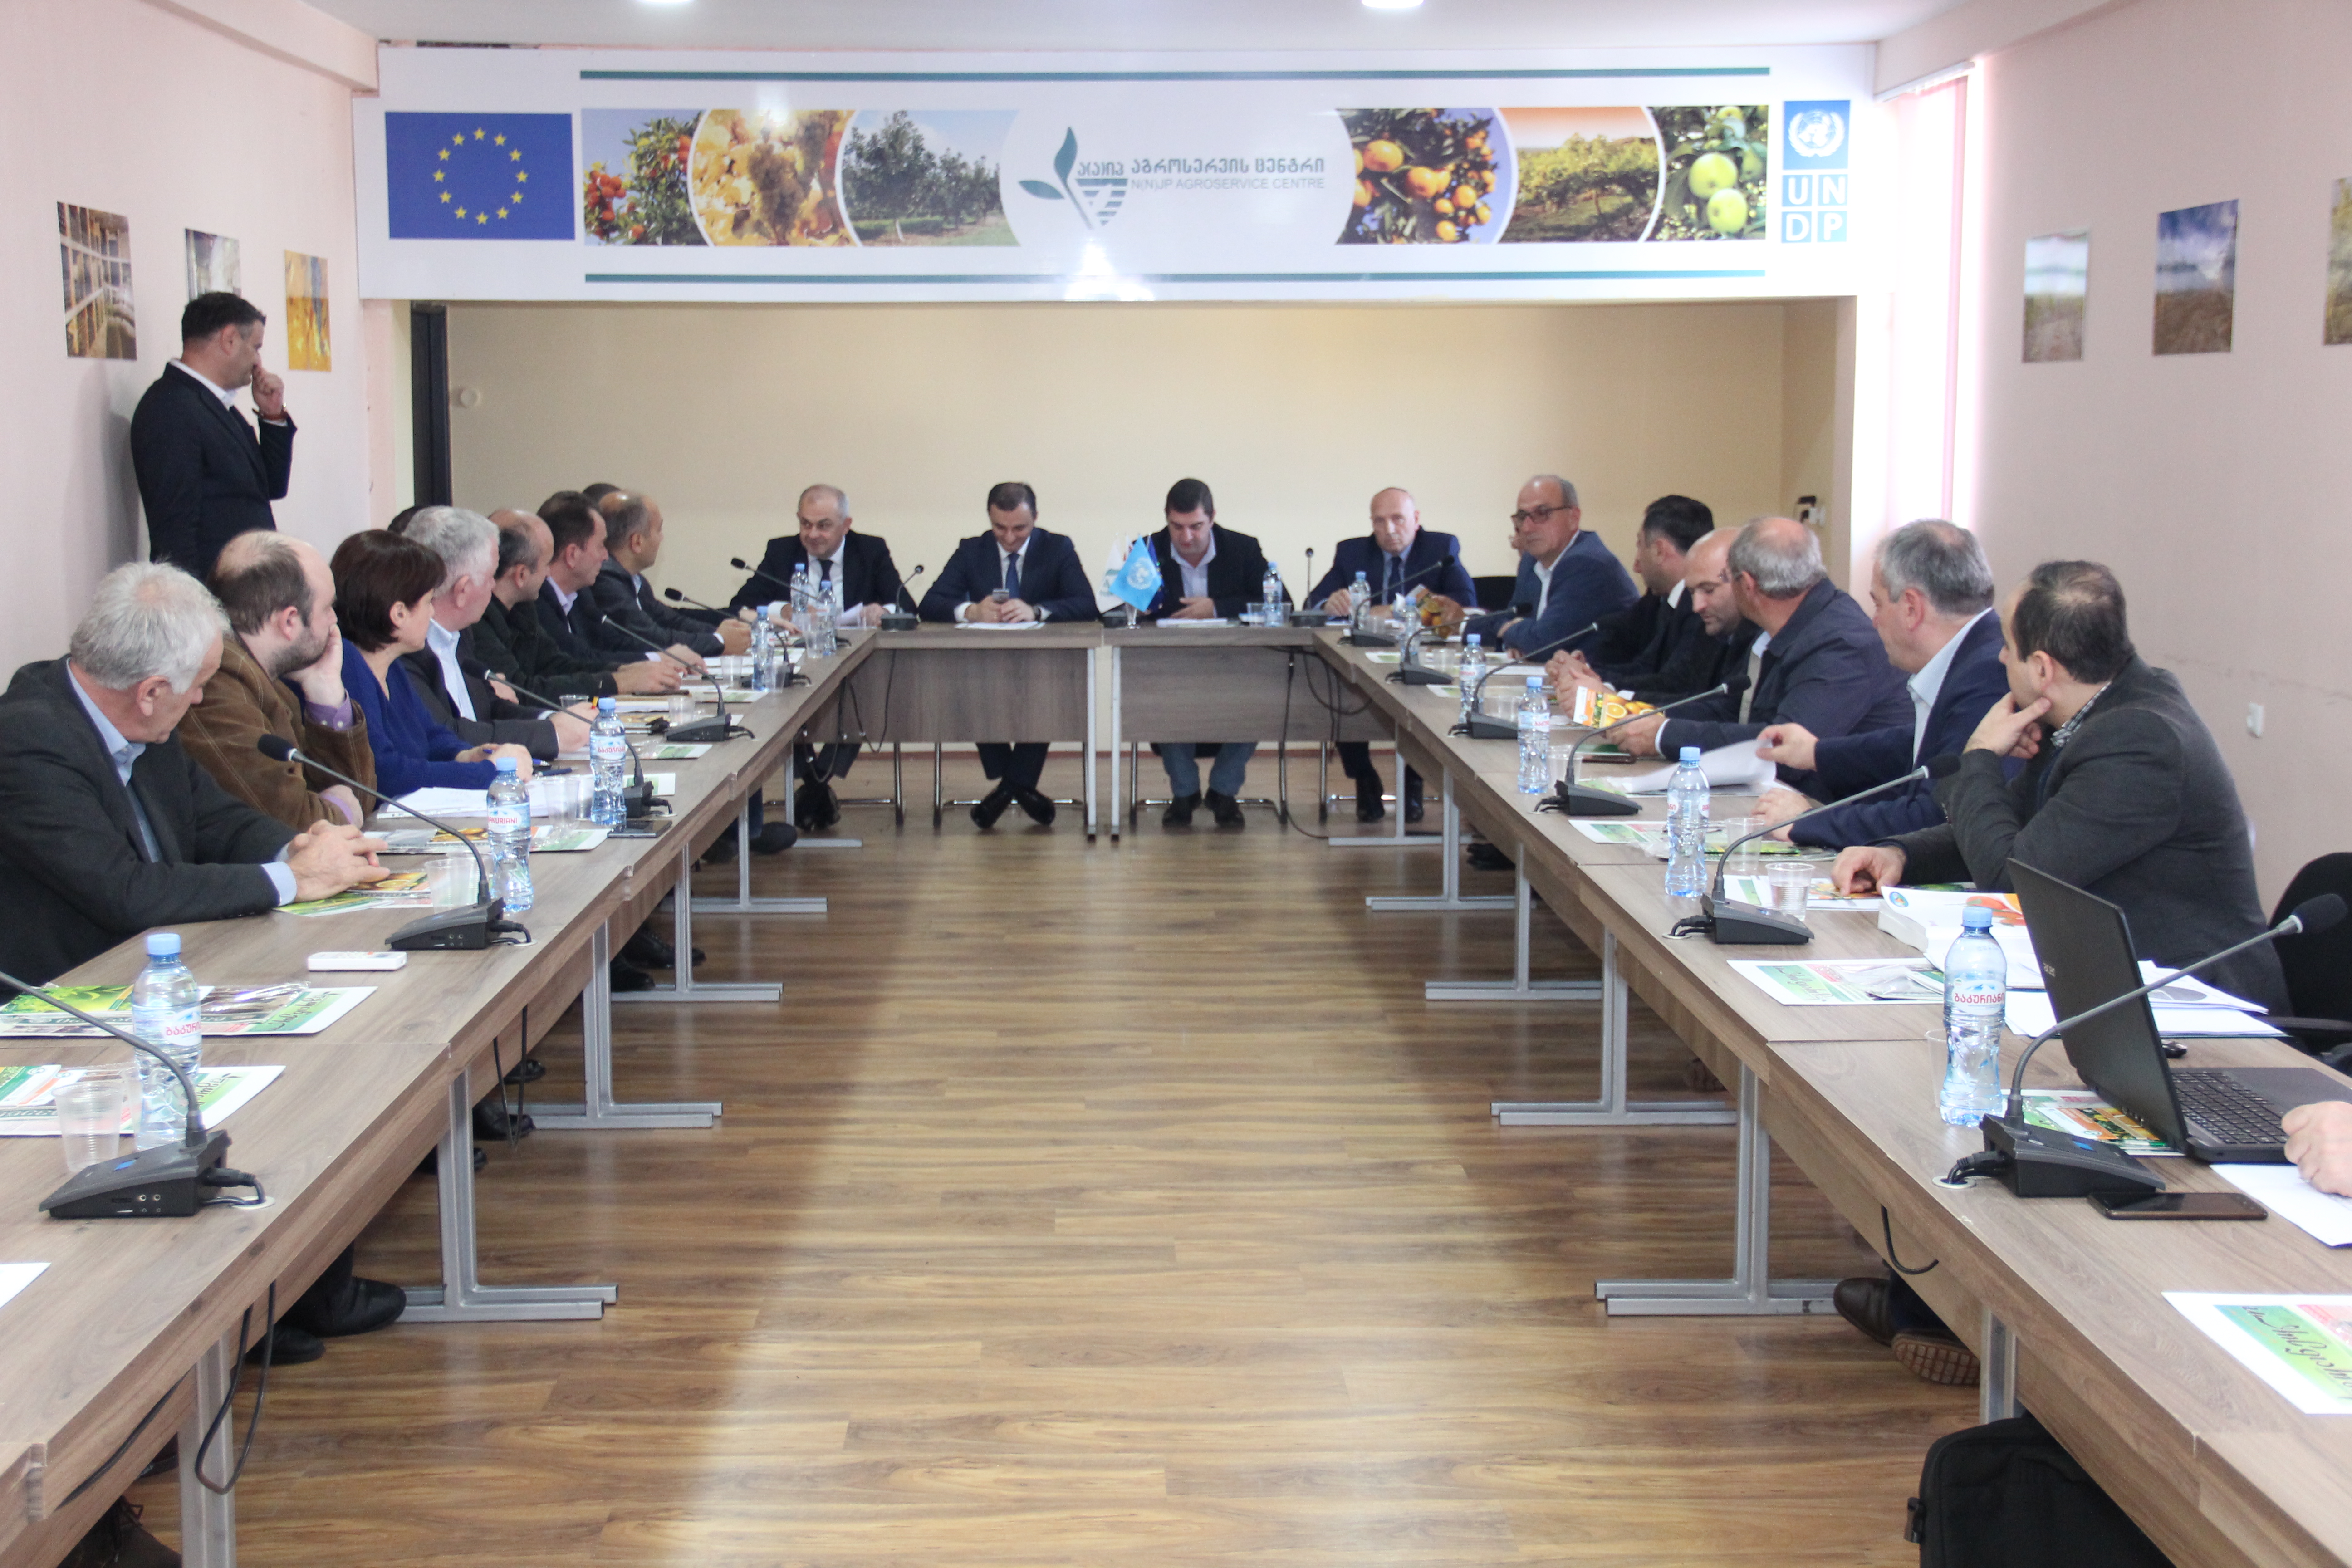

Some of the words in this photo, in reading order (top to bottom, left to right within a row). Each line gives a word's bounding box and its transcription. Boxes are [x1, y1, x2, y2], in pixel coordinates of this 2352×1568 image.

[1131, 158, 1249, 174] აგროსერვის
[1255, 157, 1324, 173] ცენტრი
[1176, 179, 1269, 190] AGROSERVICE
[1273, 179, 1325, 189] CENTRE
